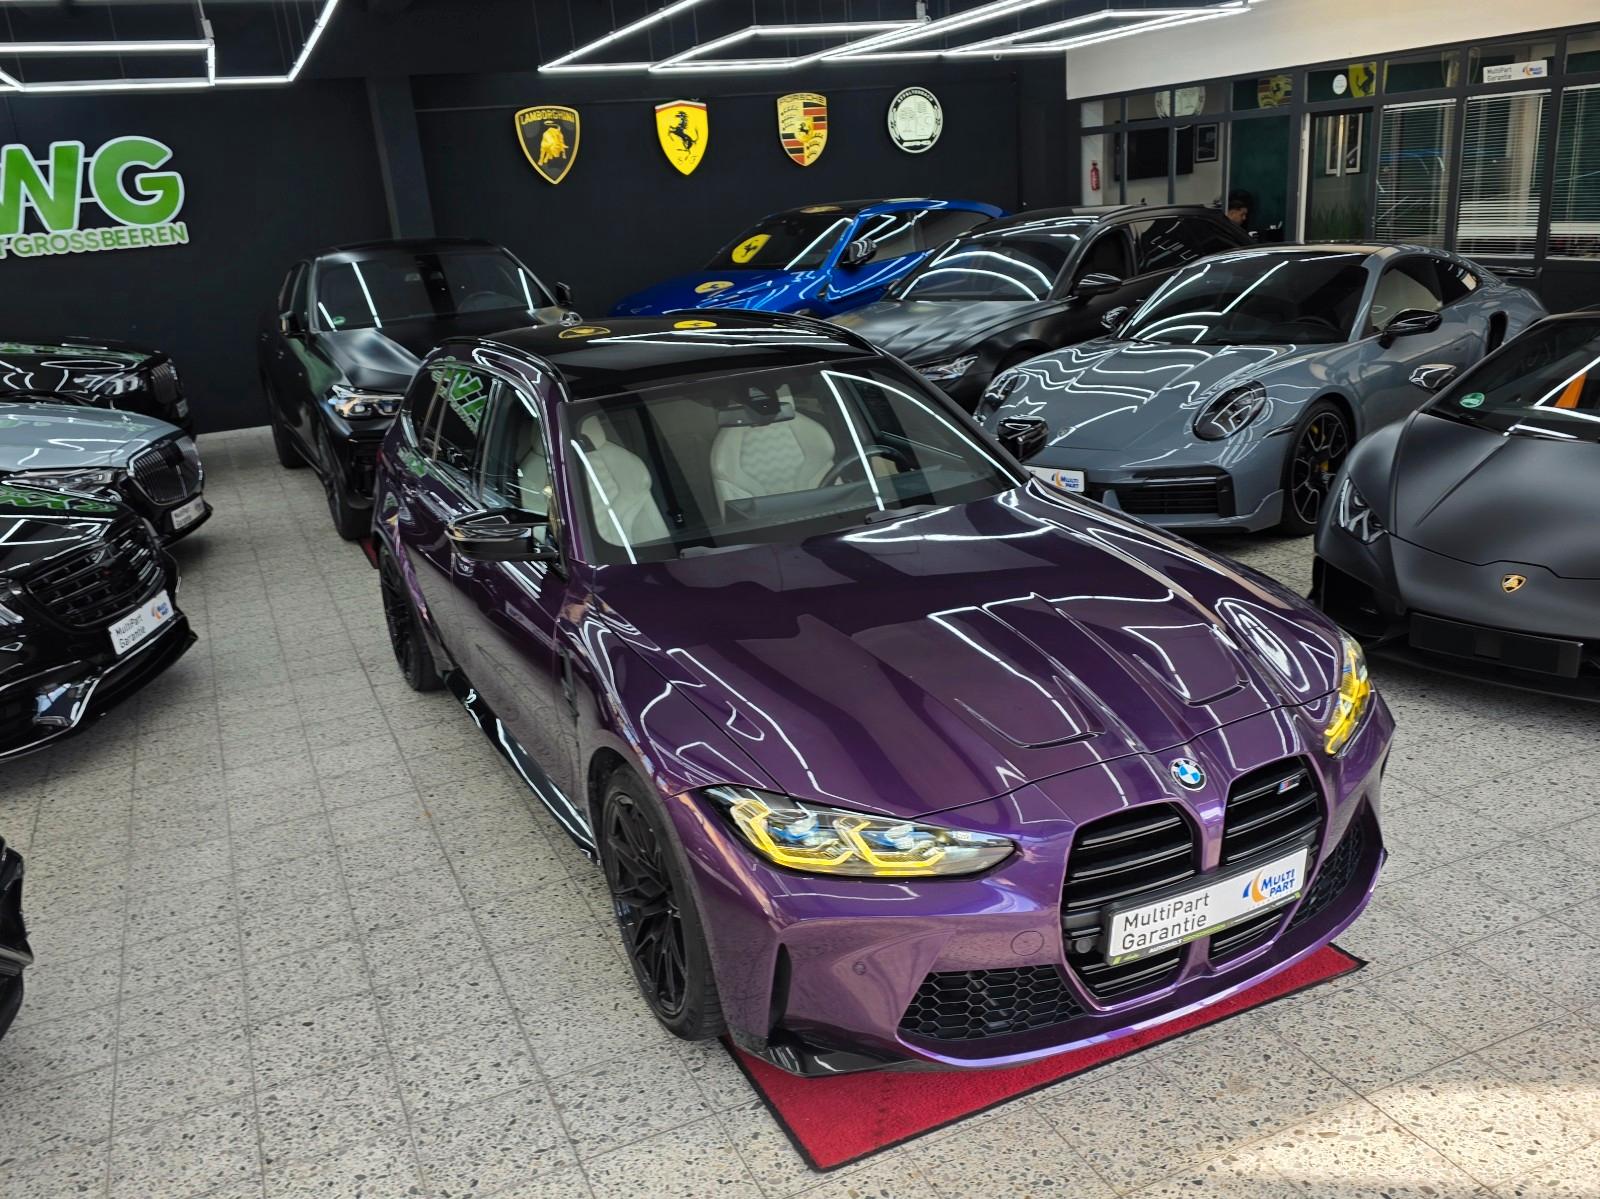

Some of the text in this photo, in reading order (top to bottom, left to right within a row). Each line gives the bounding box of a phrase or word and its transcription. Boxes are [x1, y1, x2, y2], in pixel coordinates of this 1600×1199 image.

[12, 224, 188, 257] GROSSBEEREN
[1261, 868, 1295, 889] MULTI
[1269, 878, 1295, 897] PART
[1123, 893, 1210, 931] MultiPart
[1121, 914, 1208, 951] Garantie
